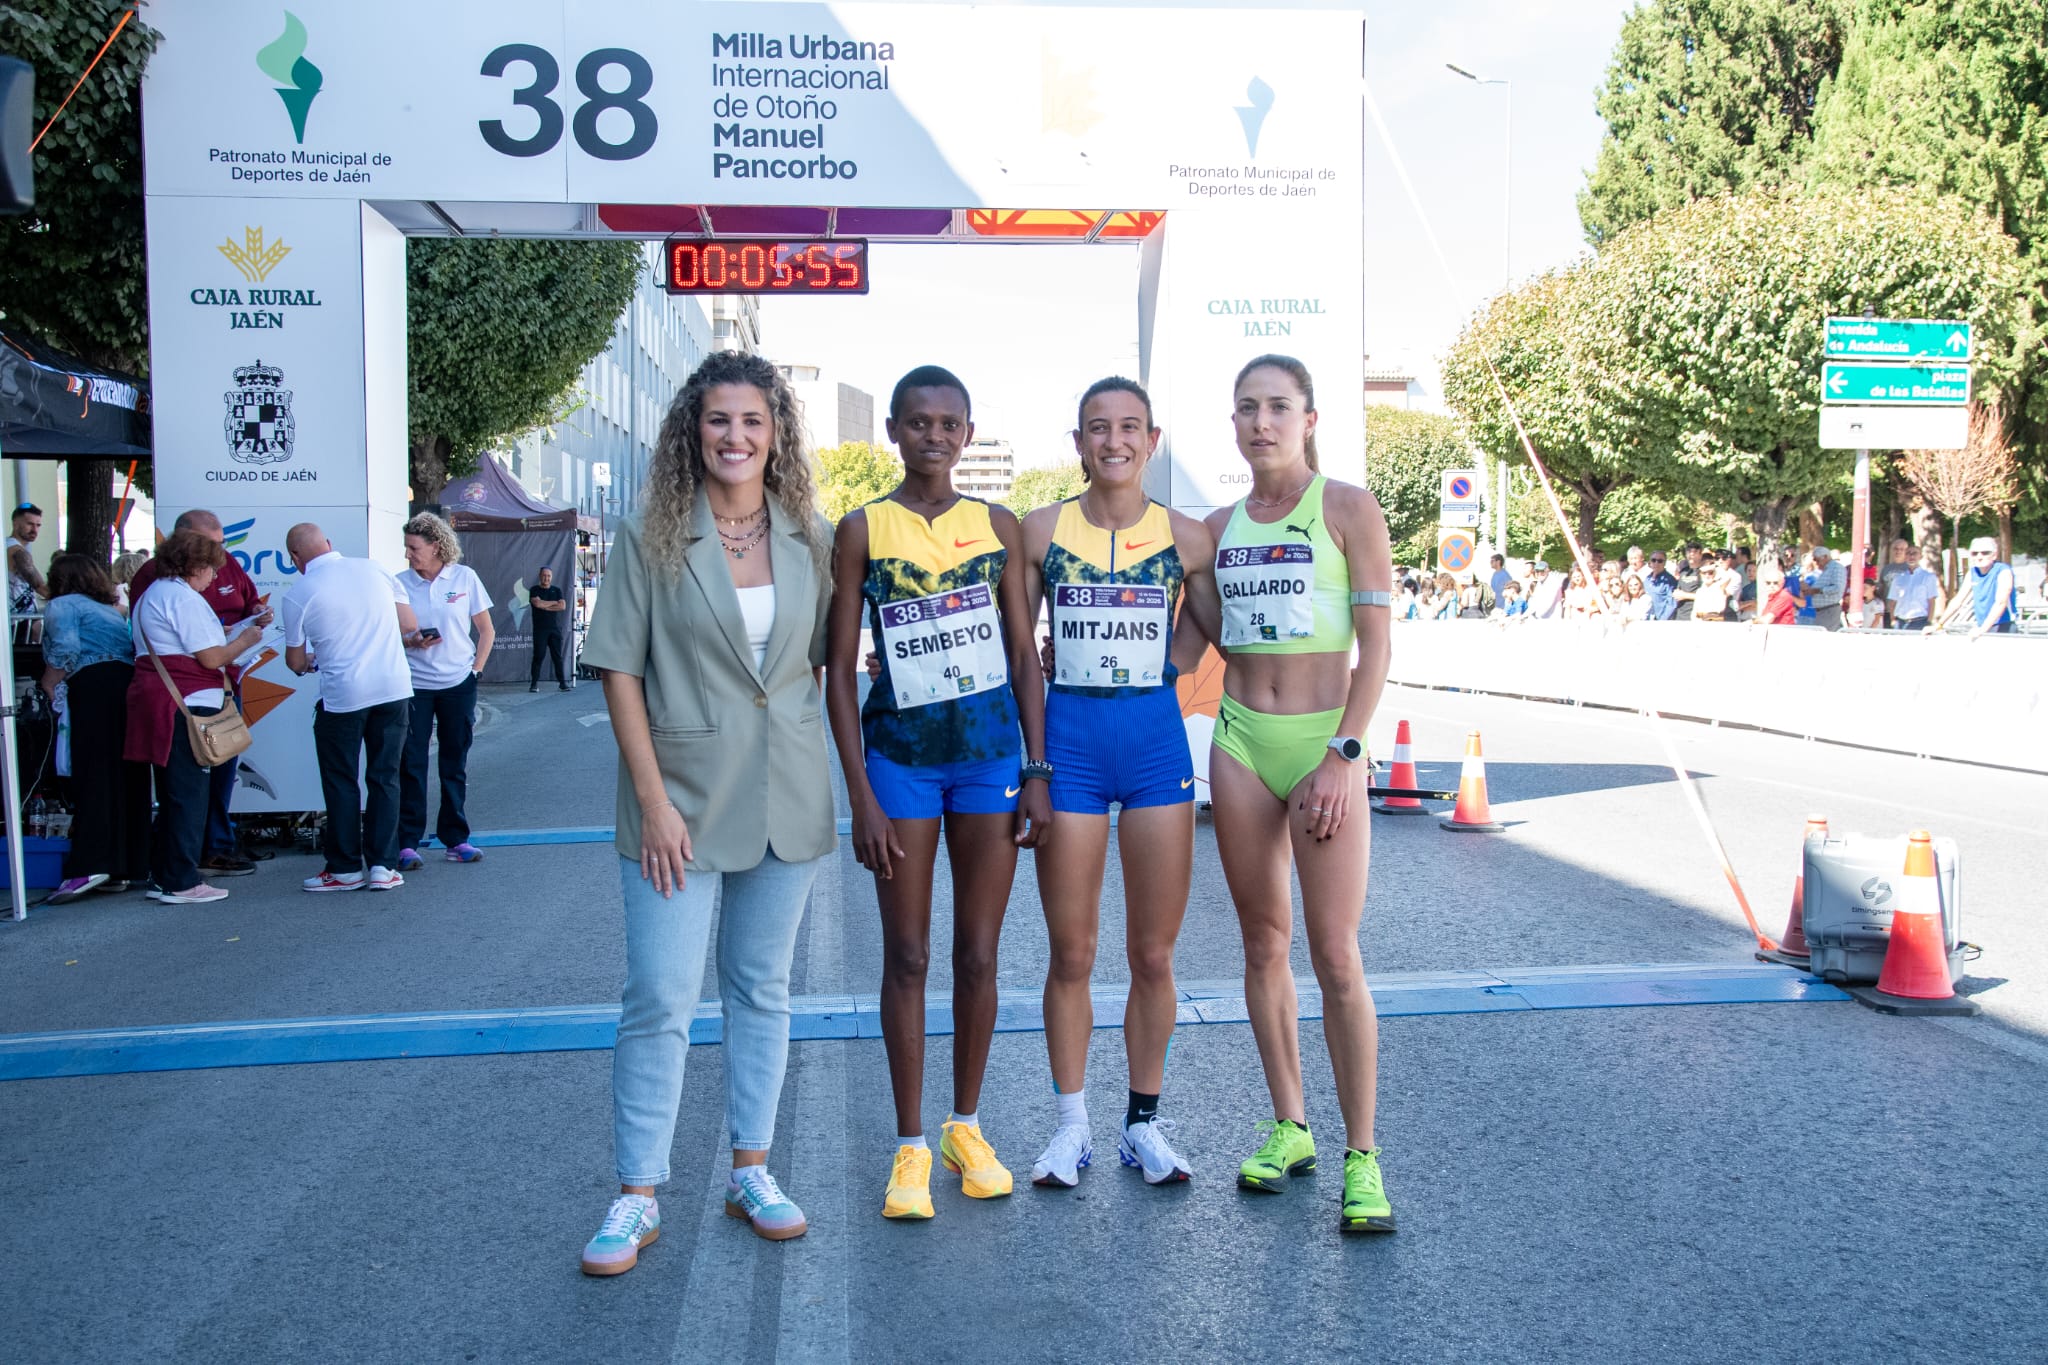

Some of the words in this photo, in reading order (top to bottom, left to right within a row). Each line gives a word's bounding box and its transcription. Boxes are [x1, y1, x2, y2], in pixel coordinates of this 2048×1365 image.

[713, 33, 782, 58] Milla
[790, 35, 893, 60] Urbana
[713, 64, 888, 89] Internacional
[479, 44, 658, 161] 38
[714, 94, 749, 119] de
[756, 95, 837, 119] Otoño
[713, 123, 823, 149] Manuel
[210, 148, 286, 164] Patronato
[291, 151, 367, 169] Municipal
[372, 153, 392, 166] de
[714, 154, 857, 180] Pancorbo
[231, 167, 303, 184] Deportes
[309, 169, 329, 183] de
[333, 168, 371, 183] Jaén
[1170, 164, 1239, 180] Patronato
[1244, 166, 1313, 184] Municipal
[1318, 167, 1336, 181] de
[1189, 182, 1255, 199] Deportes
[1259, 183, 1277, 196] de
[1282, 182, 1316, 196] Jaén
[674, 245, 858, 288] 00:05:55
[190, 288, 243, 306] CAJA
[252, 289, 321, 306] RURAL
[1207, 299, 1254, 316] CAJA
[1261, 298, 1326, 315] RURAL
[230, 309, 284, 330] JAÉN
[1244, 319, 1291, 337] JAÉN
[1830, 323, 1878, 336] avenida
[1828, 339, 1845, 351] de
[1848, 339, 1909, 352] Andalucía
[1932, 370, 1966, 384] plaza
[1870, 385, 1886, 397] de
[1889, 385, 1909, 397] las
[1912, 386, 1965, 398] Batallas
[205, 470, 258, 482] CIUDAD
[262, 471, 279, 482] DE
[282, 468, 317, 482] JAÉN
[1226, 549, 1248, 566] 38
[1067, 588, 1092, 606] 38
[1223, 579, 1305, 599] GALLARDO
[894, 603, 921, 624] 38
[1250, 613, 1265, 625] 28
[1062, 621, 1159, 641] MITJANS
[895, 622, 993, 659] SEMBEYO
[1100, 655, 1118, 668] 26
[944, 665, 961, 680] 40
